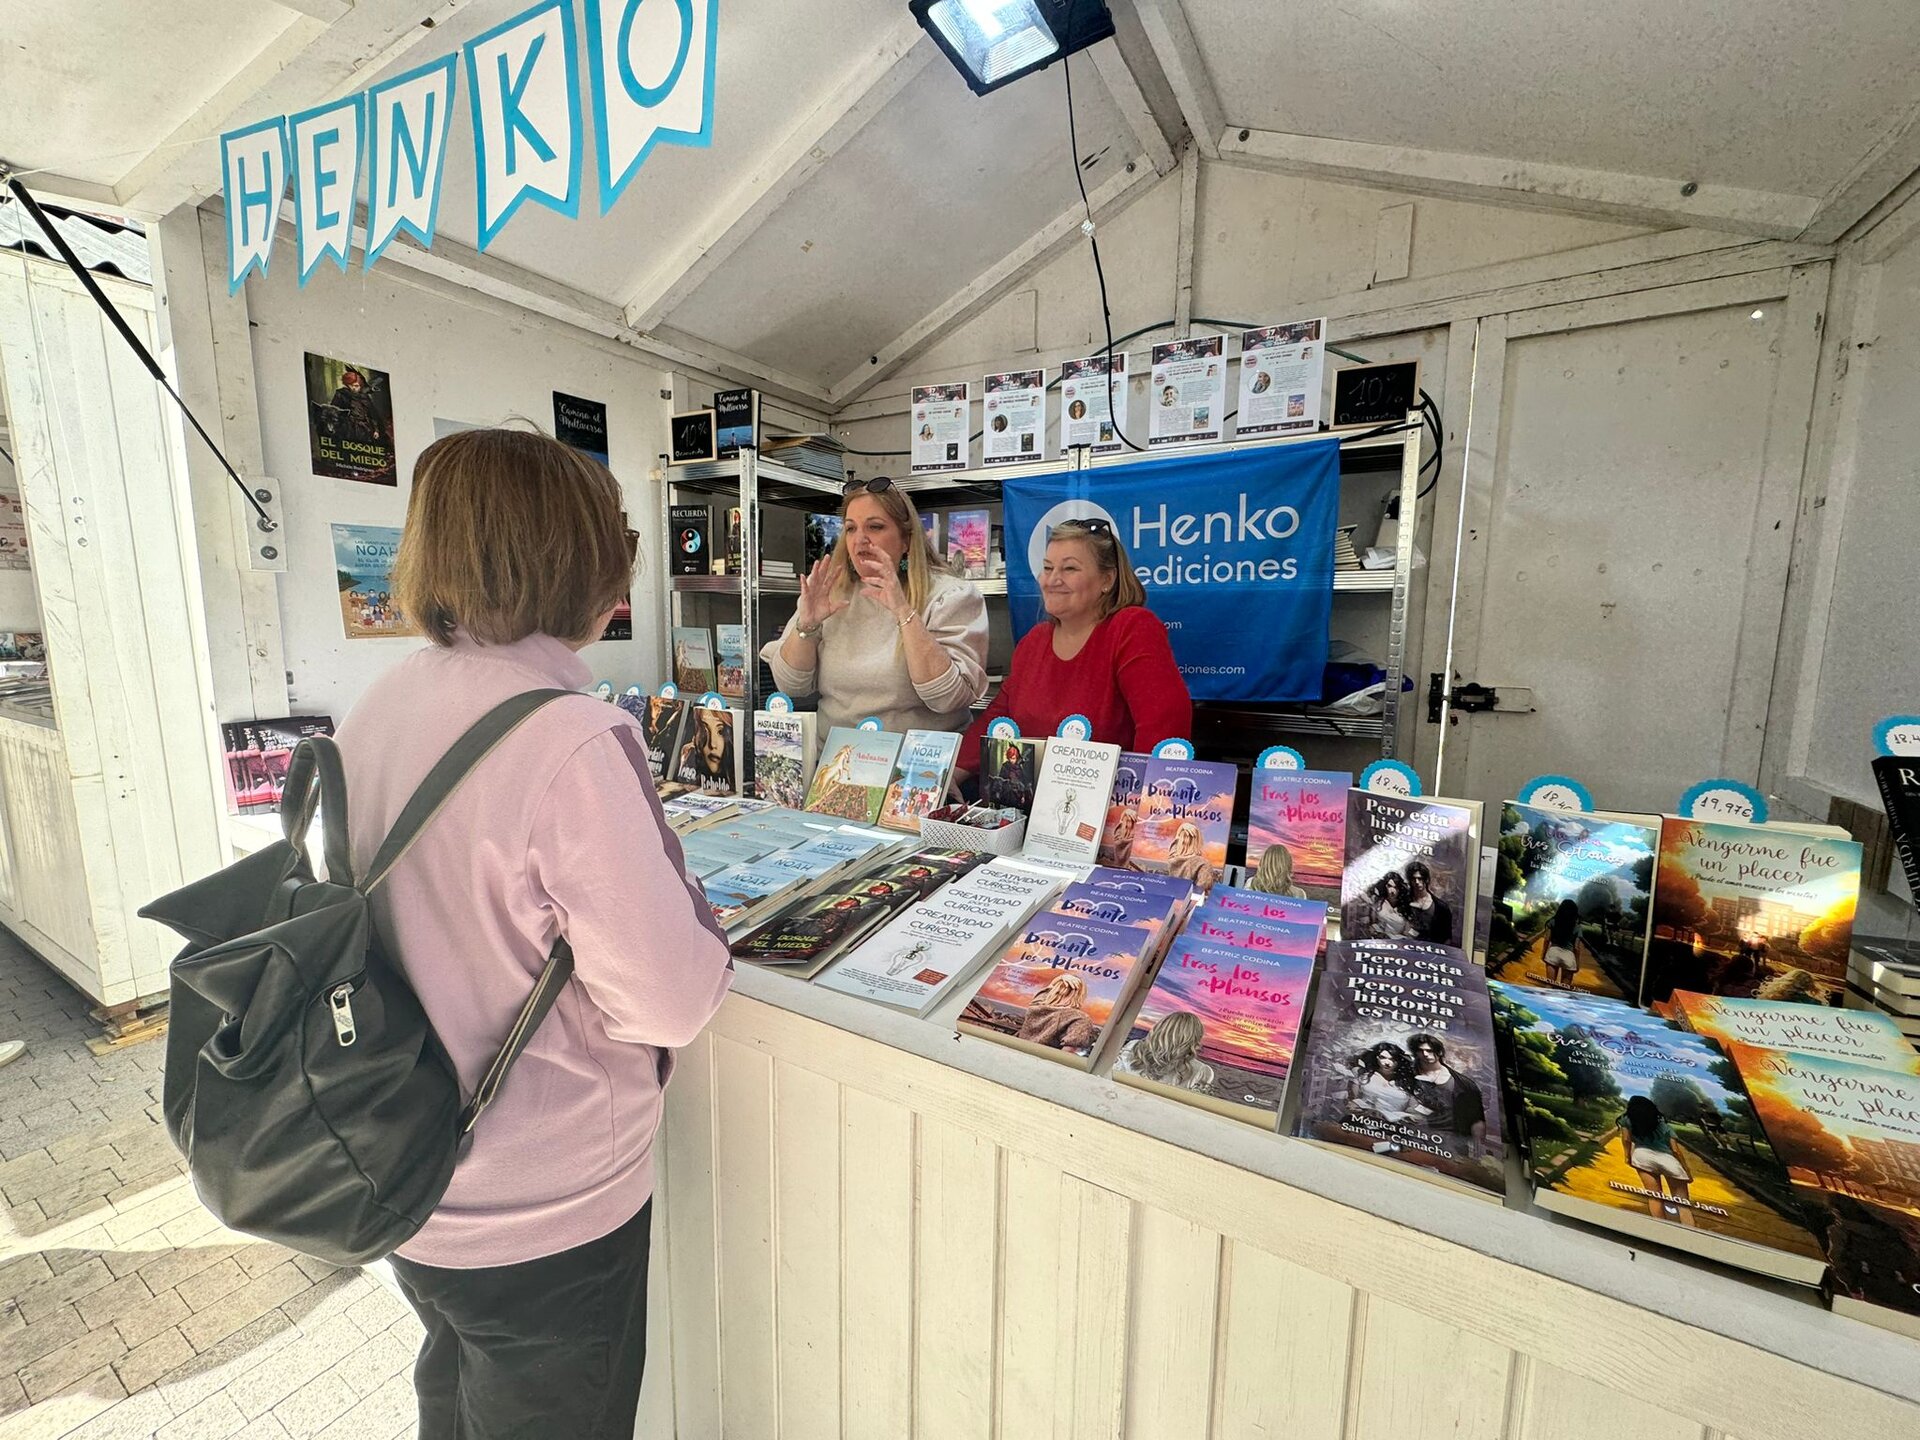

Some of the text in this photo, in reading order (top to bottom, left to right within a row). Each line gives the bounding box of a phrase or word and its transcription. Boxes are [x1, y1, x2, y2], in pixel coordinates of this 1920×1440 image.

[238, 0, 693, 247] HENKO
[320, 436, 386, 456] EL BOSQUE
[320, 448, 387, 468] DEL MIEDO
[671, 509, 707, 518] RECUERDA
[1132, 493, 1300, 549] Henko
[1133, 554, 1298, 585] ediciones
[912, 747, 942, 759] NOAH
[1052, 745, 1110, 761] CREATIVIDAD
[1070, 758, 1087, 766] para
[1053, 763, 1100, 779] CURIOSOS
[1273, 775, 1332, 785] BEATRIZ CODINA
[700, 774, 730, 792] Rebelde
[1148, 782, 1202, 803] Durante
[1262, 784, 1320, 805] Tras los
[1149, 804, 1222, 822] los aplausos
[1277, 804, 1344, 824] aplausos
[1365, 798, 1449, 828] Pero esta
[1701, 795, 1753, 818] 19,97€
[1370, 814, 1440, 842] historia
[816, 841, 855, 852] NOAH
[1373, 832, 1434, 857] es tuya
[1679, 827, 1840, 869] Vengarme fue
[774, 858, 814, 872] NOAH
[1027, 857, 1090, 871] CREATIVIDAD
[1700, 857, 1808, 885] un placer
[729, 873, 772, 887] NOAH
[976, 878, 1033, 895] CURIOSOS
[980, 868, 1049, 886] CREATIVIDAD
[1112, 874, 1167, 886] BEATRIZ CODINA
[948, 888, 1022, 907] CREATIVIDAD
[1090, 890, 1148, 904] BEATRIZ CODINA
[1235, 892, 1302, 908] BEATRIZ CODINA
[943, 900, 1005, 918] CURIOSOS
[1061, 899, 1128, 923] Durante
[1219, 896, 1286, 919] Tras los
[915, 907, 994, 929] CREATIVIDAD
[935, 920, 960, 928] para
[1056, 920, 1120, 936] BEATRIZ CODINA
[1218, 916, 1291, 934] BEATRIZ CODINA
[776, 934, 822, 943] BOSQUE
[909, 920, 975, 940] CURIOSOS
[1201, 922, 1273, 948] Tras los
[748, 940, 812, 950] DEL MIEDO
[1024, 931, 1099, 958] Durante
[1403, 943, 1447, 956] esta
[1020, 951, 1037, 962] los
[1041, 954, 1121, 981] aplausos
[1201, 947, 1281, 967] BEATRIZ CODINA
[1354, 951, 1464, 977] Pero esta
[1181, 953, 1217, 974] Tras
[1233, 964, 1260, 983] los
[1361, 963, 1456, 988] historia
[1197, 976, 1291, 1006] aplausos
[1347, 976, 1466, 1006] Pero esta
[1353, 989, 1456, 1018] historia
[1357, 1005, 1449, 1031] es tuya
[1700, 998, 1826, 1027] Vengarme
[1835, 1015, 1881, 1034] fue
[1735, 1023, 1865, 1048] un placer
[1568, 1056, 1582, 1064] las
[1759, 1055, 1915, 1102] Vengarme
[1802, 1087, 1920, 1123] un plac
[1351, 1113, 1443, 1145] Mónica de la O
[1801, 1104, 1838, 1118] ¿Puede
[1852, 1117, 1879, 1127] amor
[1880, 1123, 1914, 1135] vencer
[1341, 1122, 1452, 1159] Samuel Camacho
